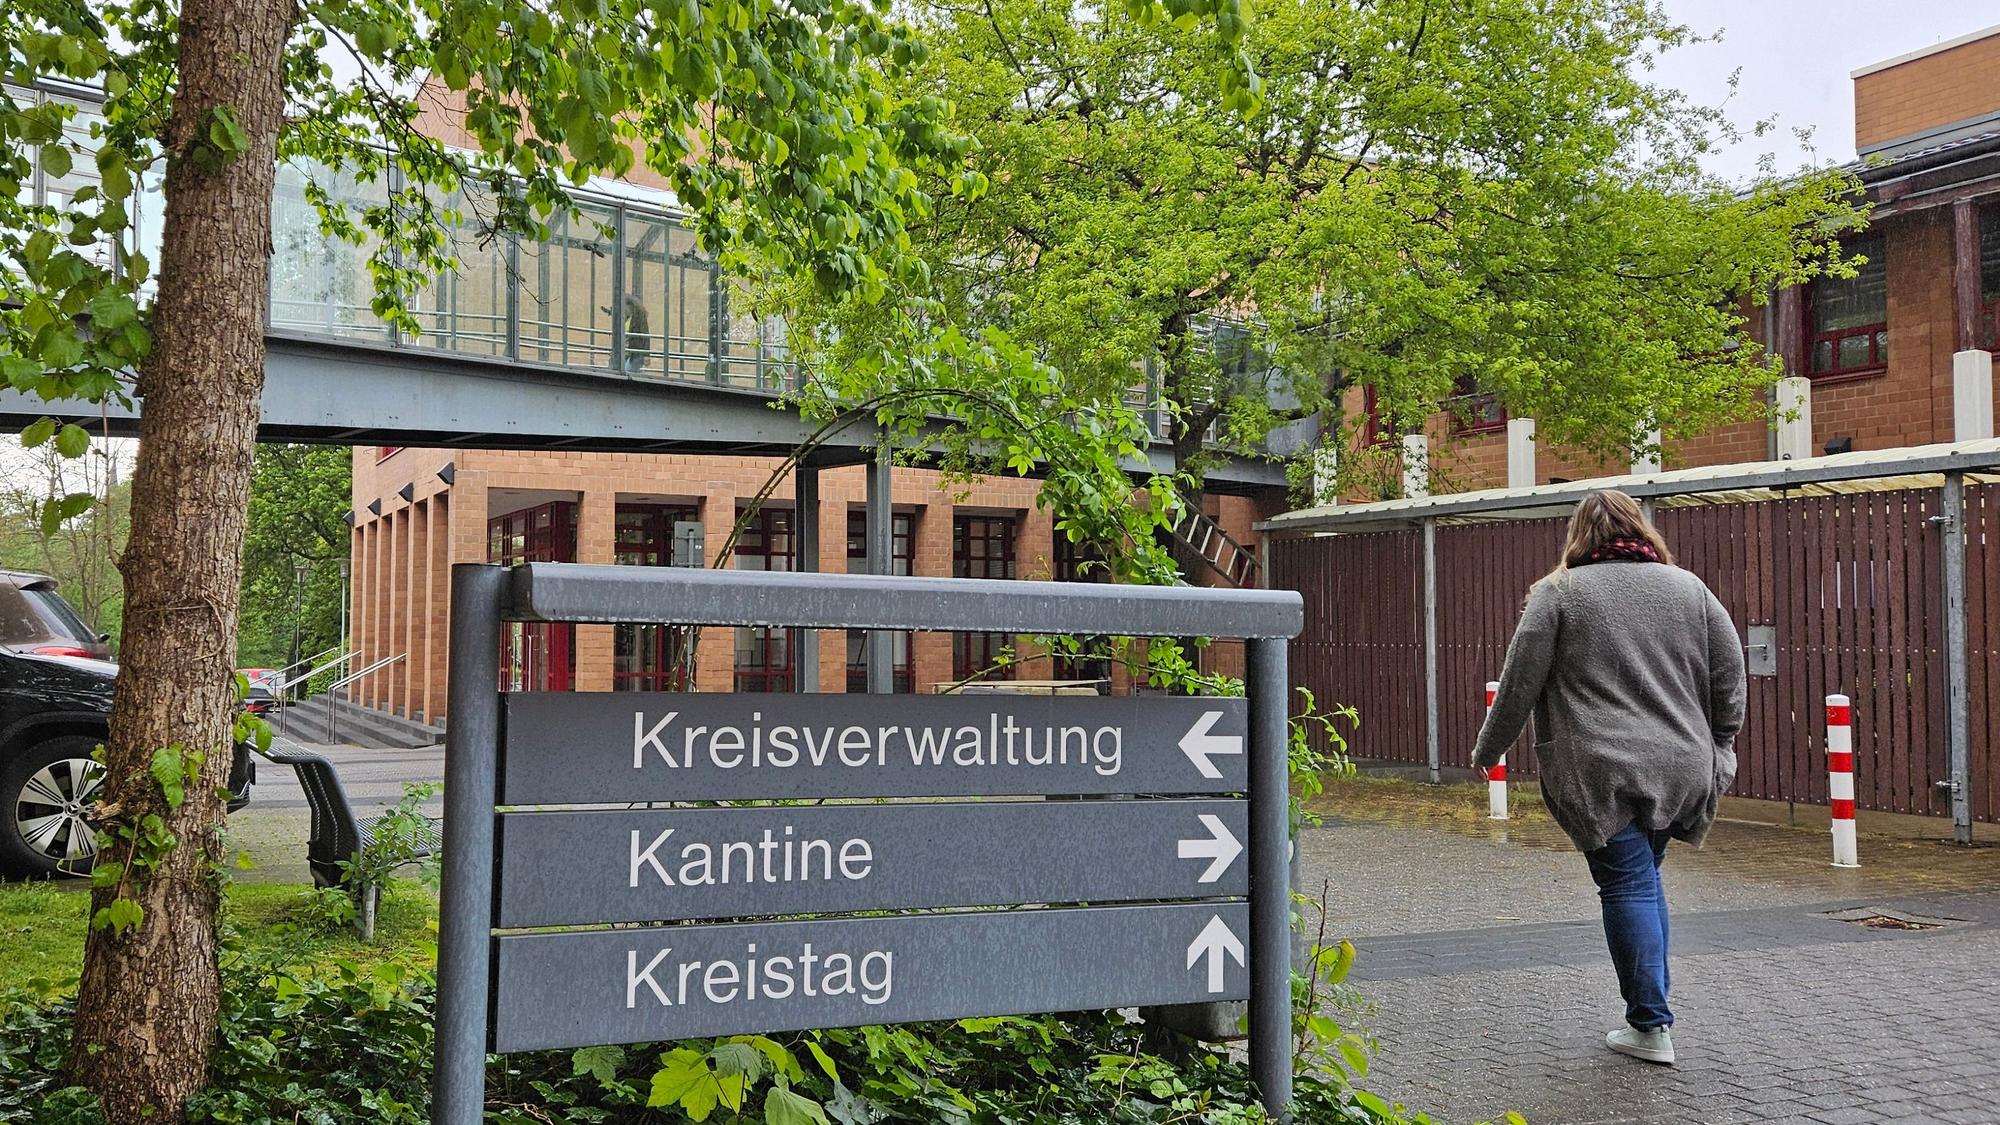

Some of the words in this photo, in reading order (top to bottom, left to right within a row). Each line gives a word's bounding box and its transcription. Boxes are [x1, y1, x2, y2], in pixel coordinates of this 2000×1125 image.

[633, 711, 1122, 776] Kreisverwaltung
[629, 825, 873, 888] Kantine
[626, 943, 893, 1009] Kreistag
